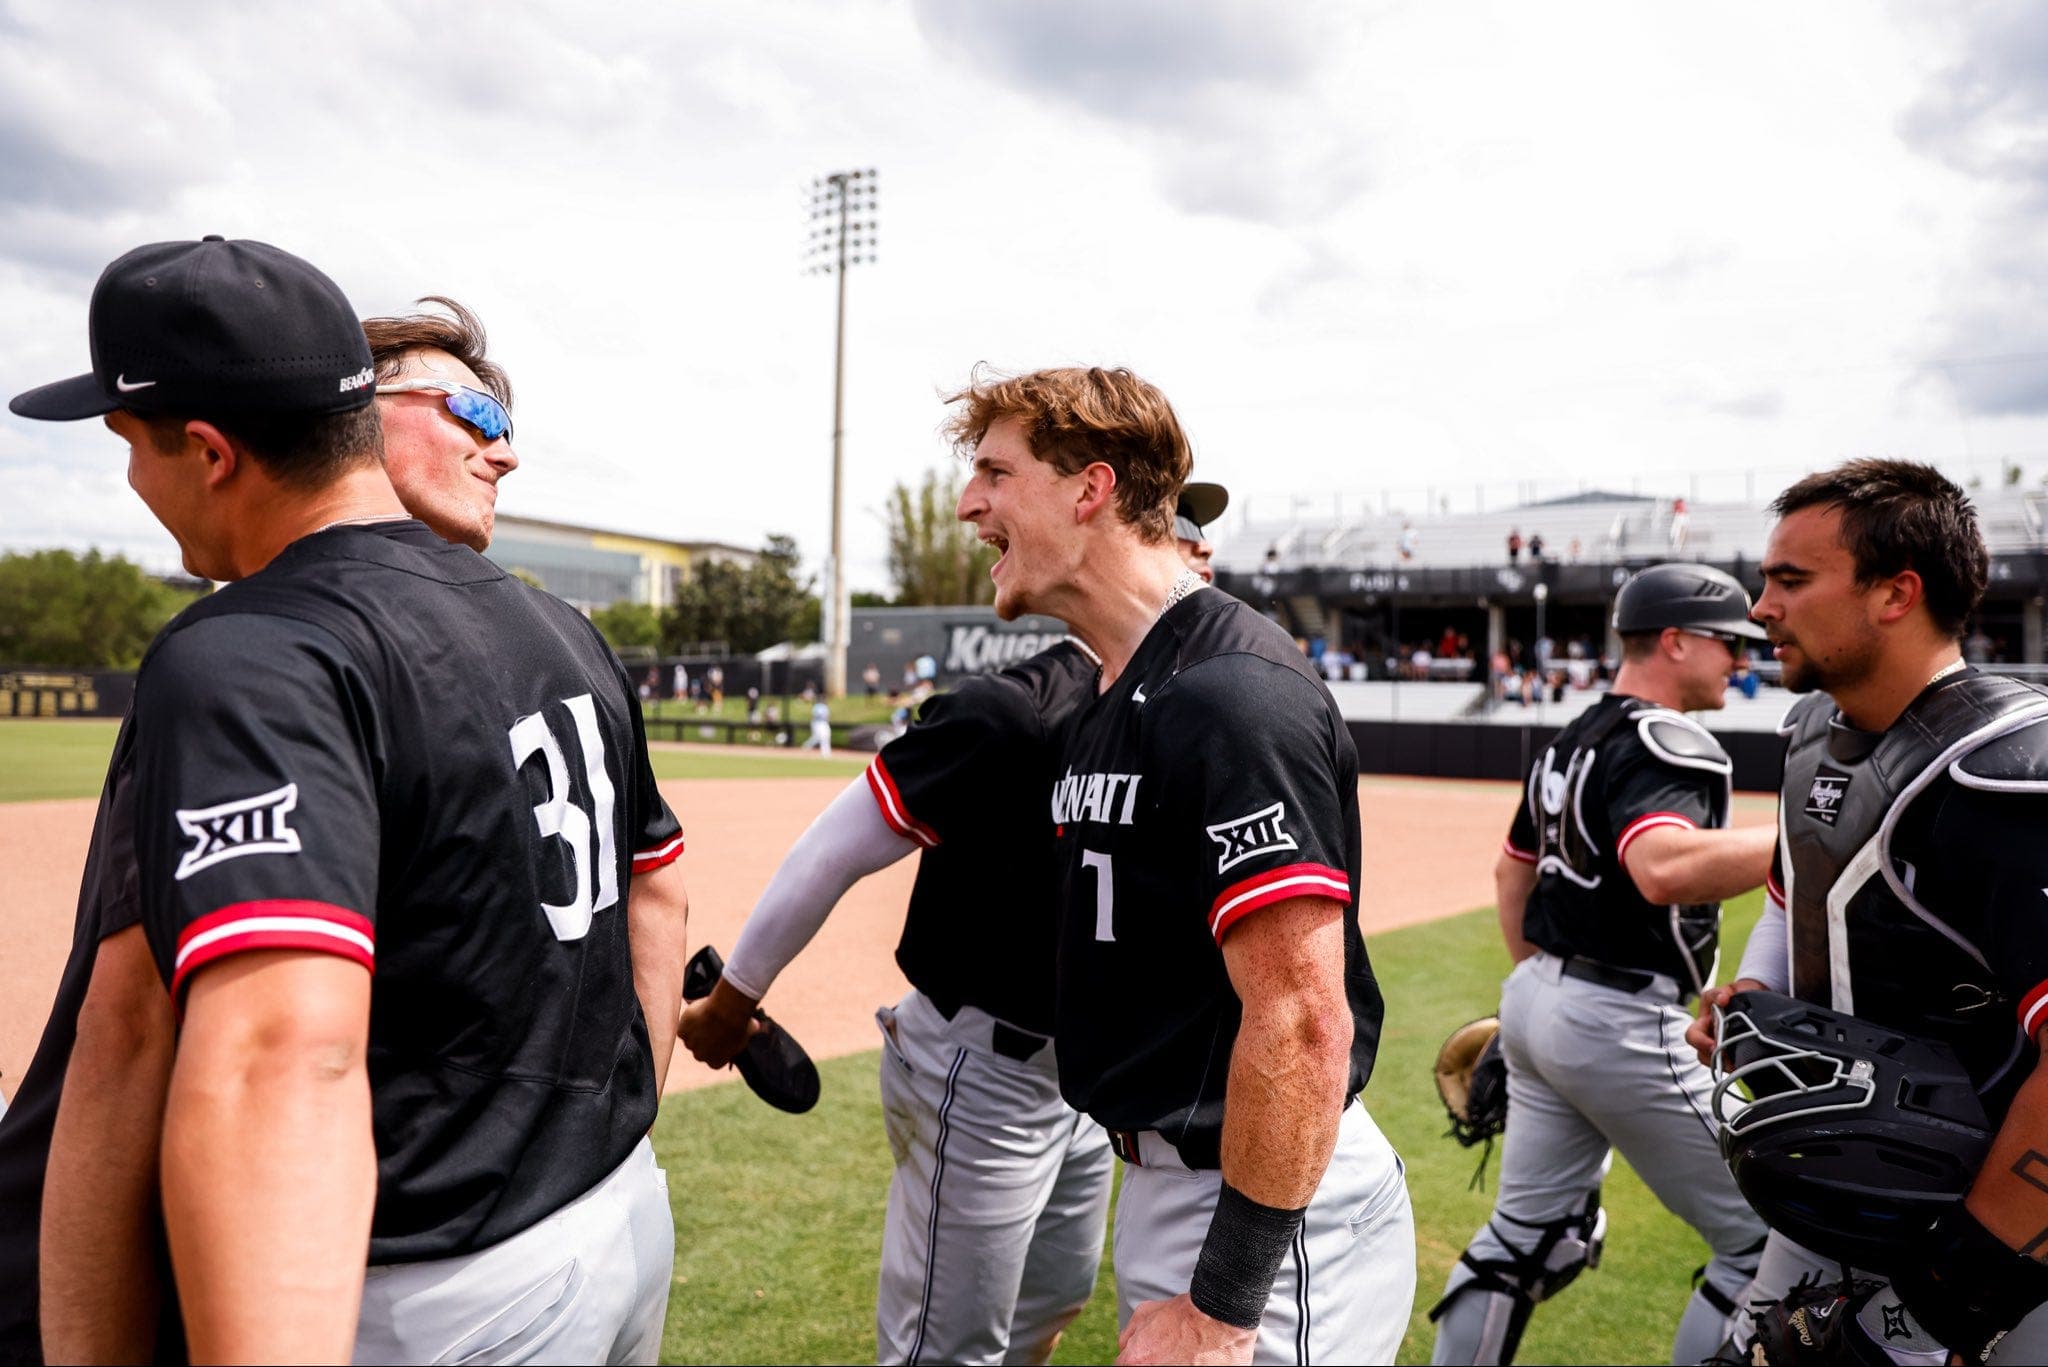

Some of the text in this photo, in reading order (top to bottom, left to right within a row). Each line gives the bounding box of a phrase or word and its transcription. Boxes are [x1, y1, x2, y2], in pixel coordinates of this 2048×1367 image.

[179, 787, 298, 874] XII
[508, 693, 619, 941] 31
[1209, 804, 1295, 871] XII
